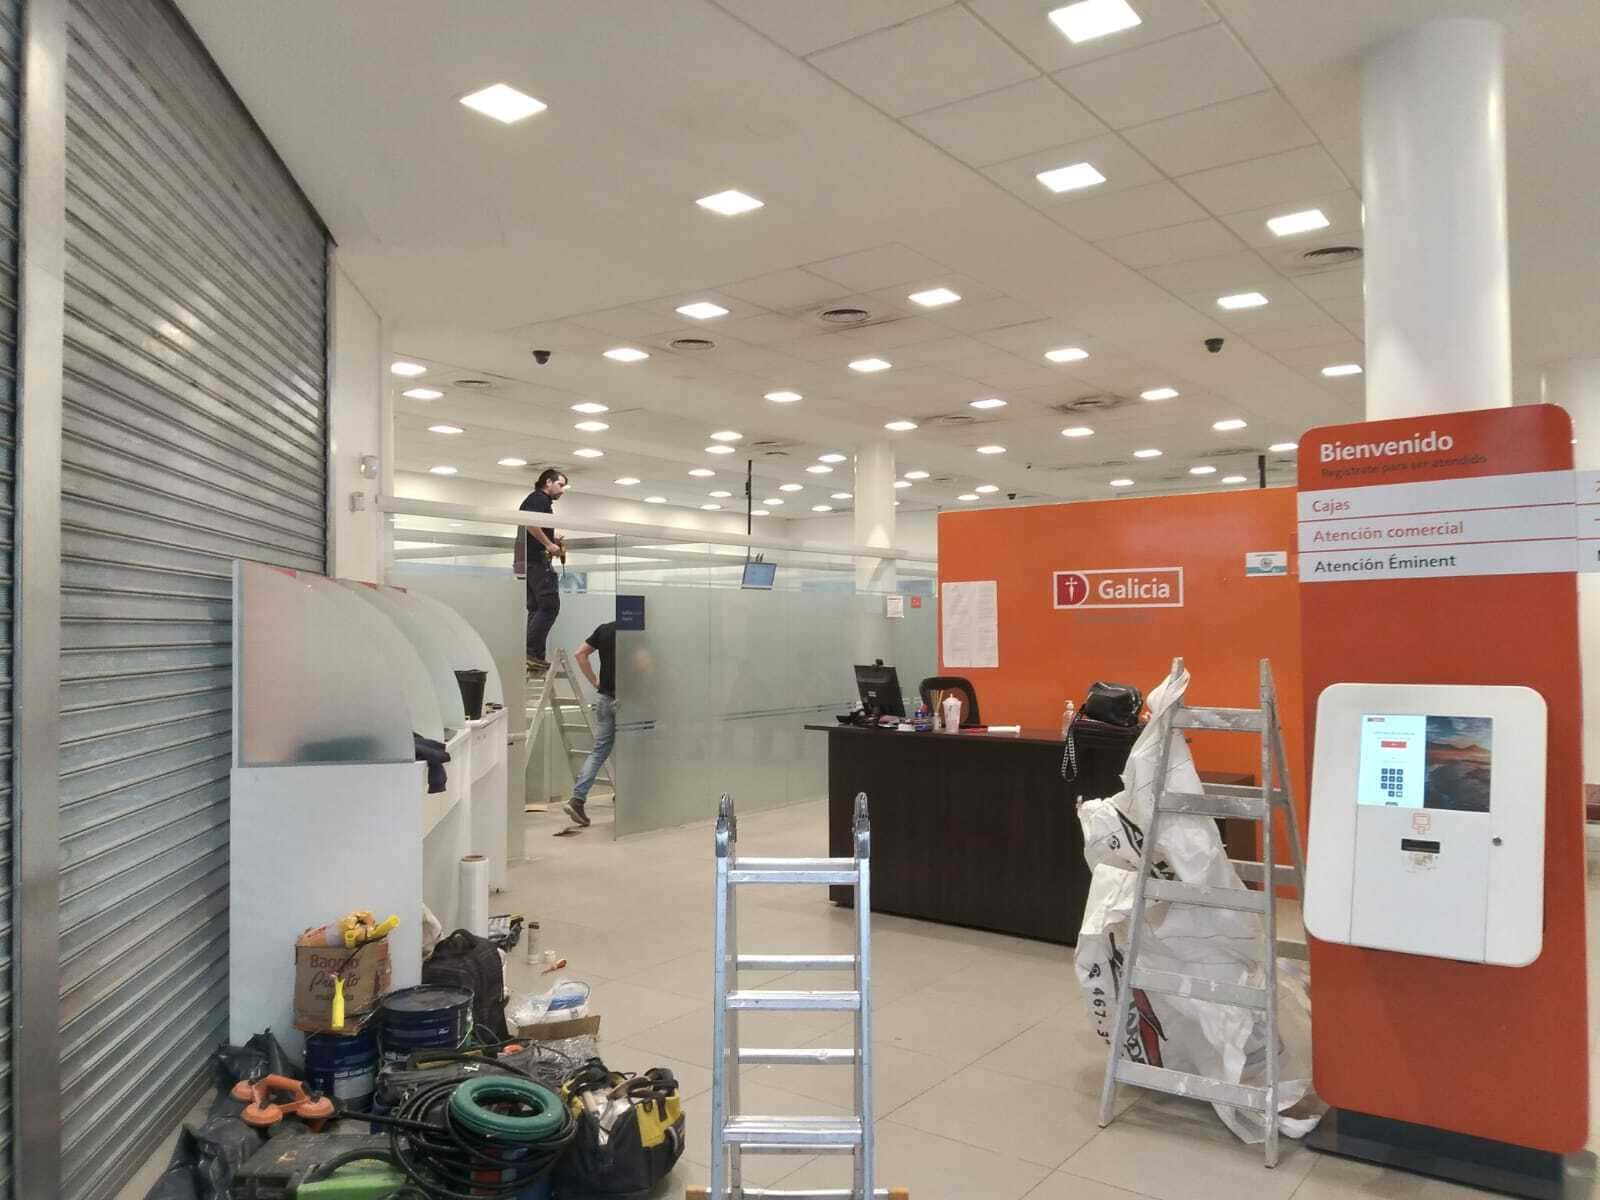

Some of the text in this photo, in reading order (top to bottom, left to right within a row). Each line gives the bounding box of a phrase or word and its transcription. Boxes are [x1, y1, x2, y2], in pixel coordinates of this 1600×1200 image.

[1320, 431, 1454, 462] Bienvenido
[1382, 462, 1408, 474] para
[1411, 460, 1428, 471] ser
[1431, 455, 1488, 469] atendido
[1312, 499, 1351, 515] Cajas
[1313, 521, 1465, 543] Atención comercial
[1314, 554, 1457, 574] Atención Éminent
[1098, 578, 1170, 600] Galicia
